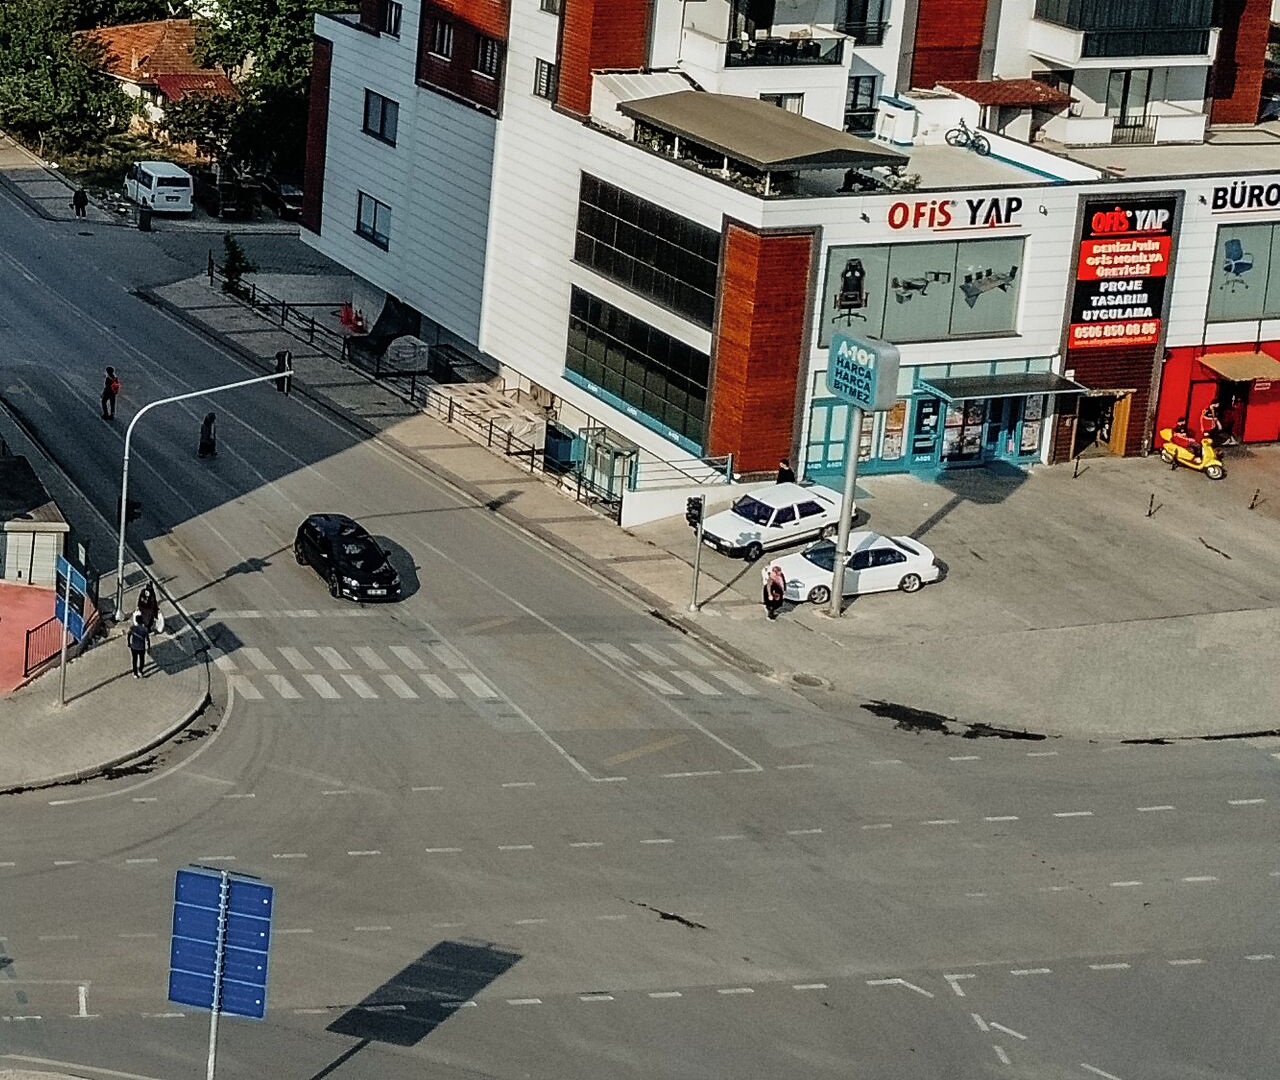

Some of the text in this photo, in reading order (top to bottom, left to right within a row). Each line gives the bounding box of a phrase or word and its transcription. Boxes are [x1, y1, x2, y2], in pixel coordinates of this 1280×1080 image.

[1212, 181, 1280, 209] BÜRO
[966, 197, 1022, 225] YAP
[1135, 209, 1170, 230] YAP
[1099, 280, 1143, 292] PROJE
[1091, 294, 1148, 306] TASARIM
[1082, 307, 1153, 320] UYGULAMA
[837, 357, 872, 380] HARCA
[835, 368, 870, 393] HARCA
